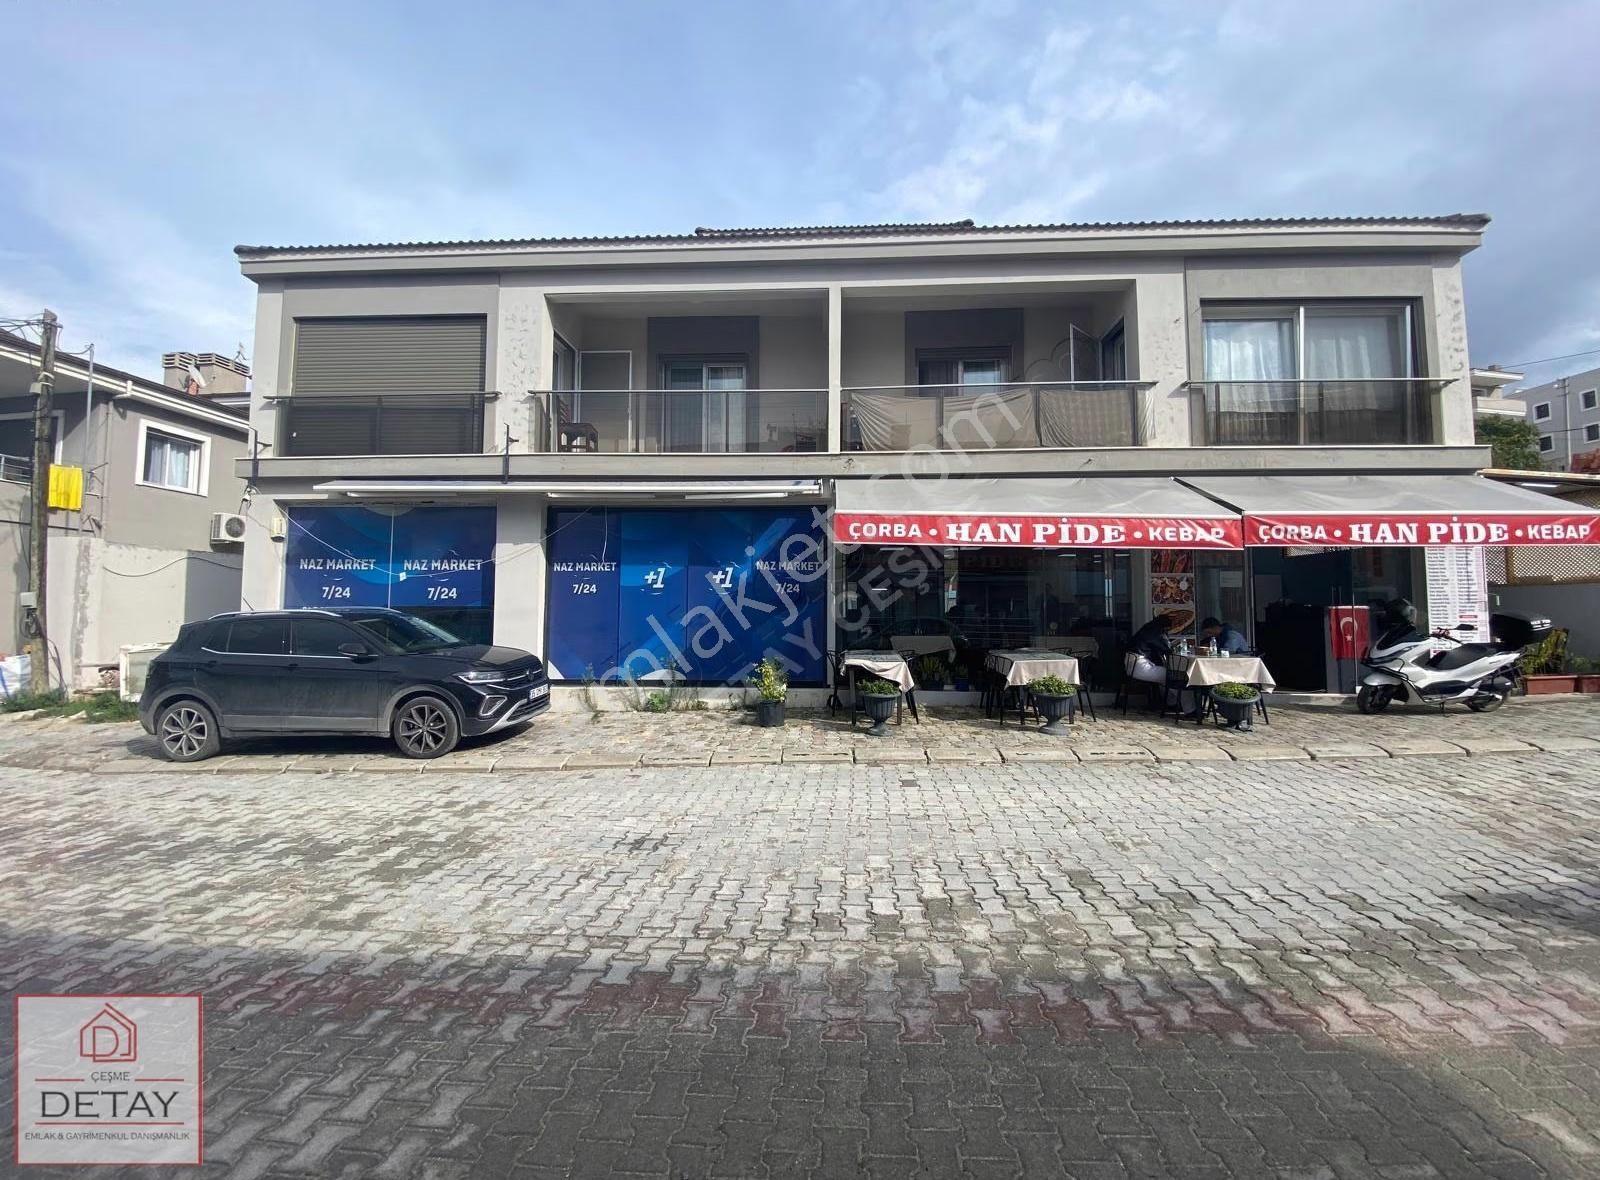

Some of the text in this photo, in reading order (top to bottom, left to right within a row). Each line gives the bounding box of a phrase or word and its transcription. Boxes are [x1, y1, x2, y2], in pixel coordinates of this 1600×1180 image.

[848, 517, 1225, 545] ÇORBA HAN PİDE KEBAP
[1258, 516, 1591, 543] ÇORBA HAN PİDE KEBAP
[300, 559, 376, 570] NAZ MARKET
[404, 560, 483, 571] NAZ MARKET
[553, 562, 617, 572] NAZ MARKET
[756, 561, 820, 571] NAZ MARKET
[644, 567, 666, 588] +1
[712, 567, 734, 588] +1
[322, 587, 351, 599] 7/24
[427, 588, 457, 600] 7/24
[572, 584, 597, 594] 7/24
[775, 583, 800, 594] 7/24
